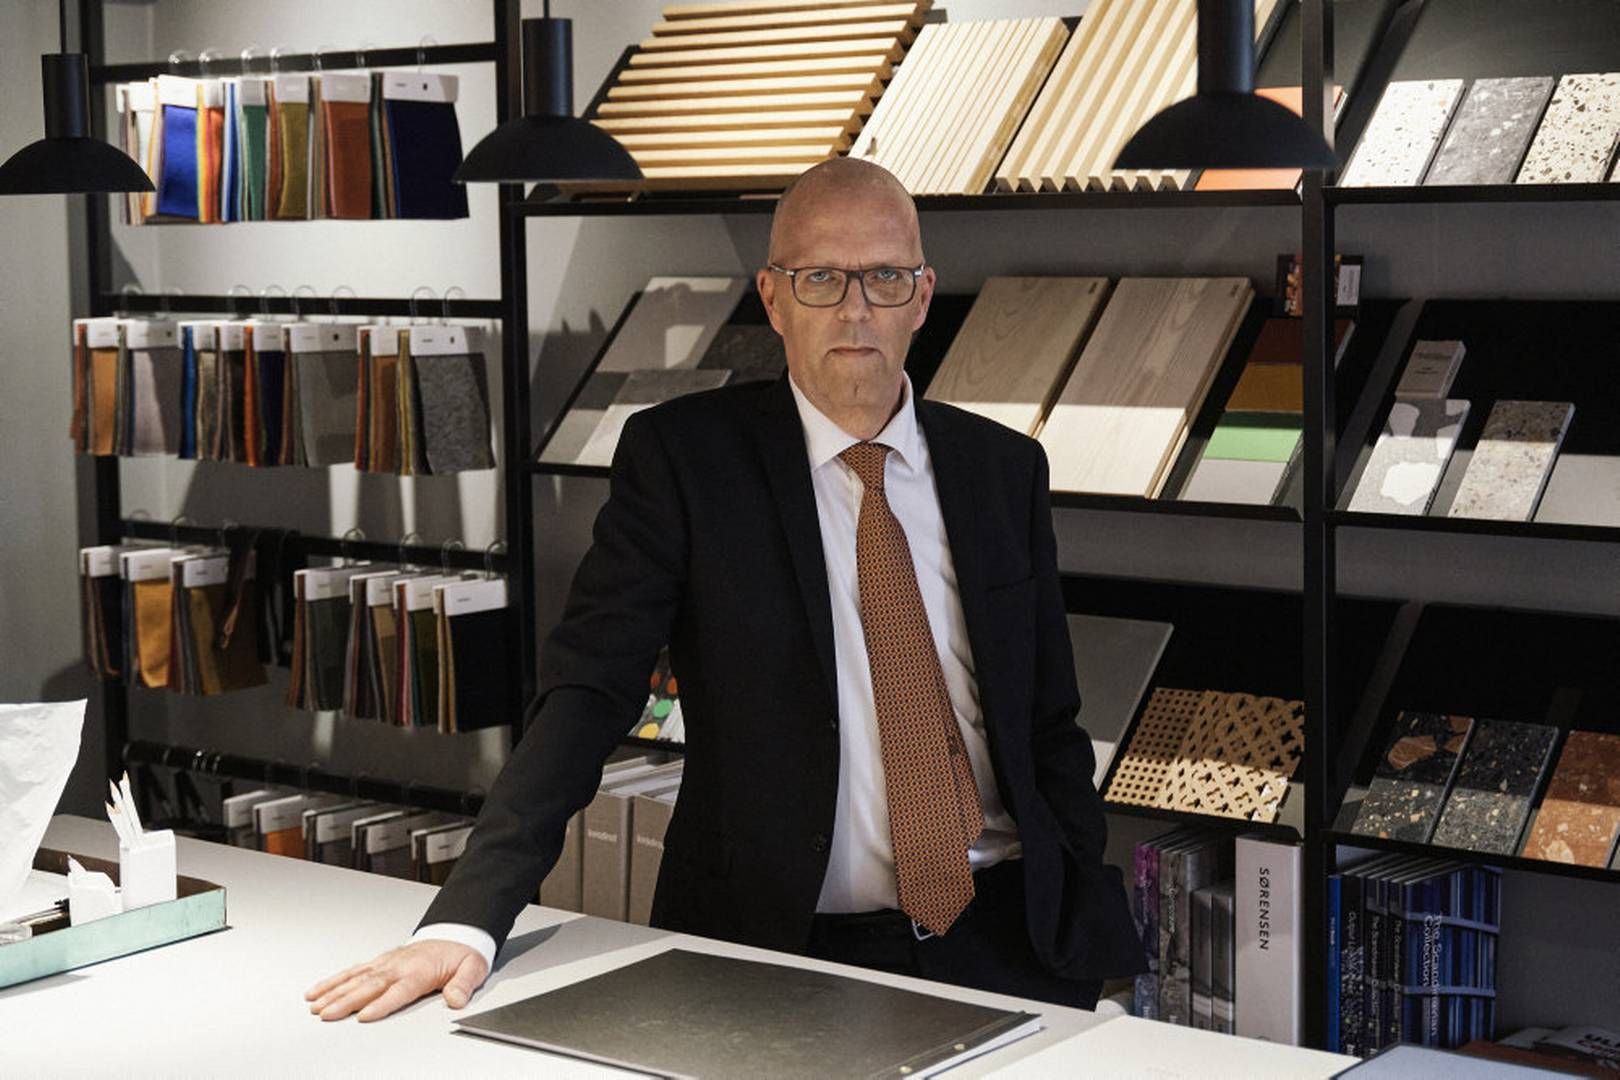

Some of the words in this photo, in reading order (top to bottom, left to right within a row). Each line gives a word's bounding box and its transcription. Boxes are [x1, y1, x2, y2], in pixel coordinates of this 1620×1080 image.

[1259, 866, 1271, 951] SØRENSEN
[1432, 915, 1442, 939] The
[1423, 915, 1433, 987] Collection
[1431, 943, 1442, 1037] Scandinavian
